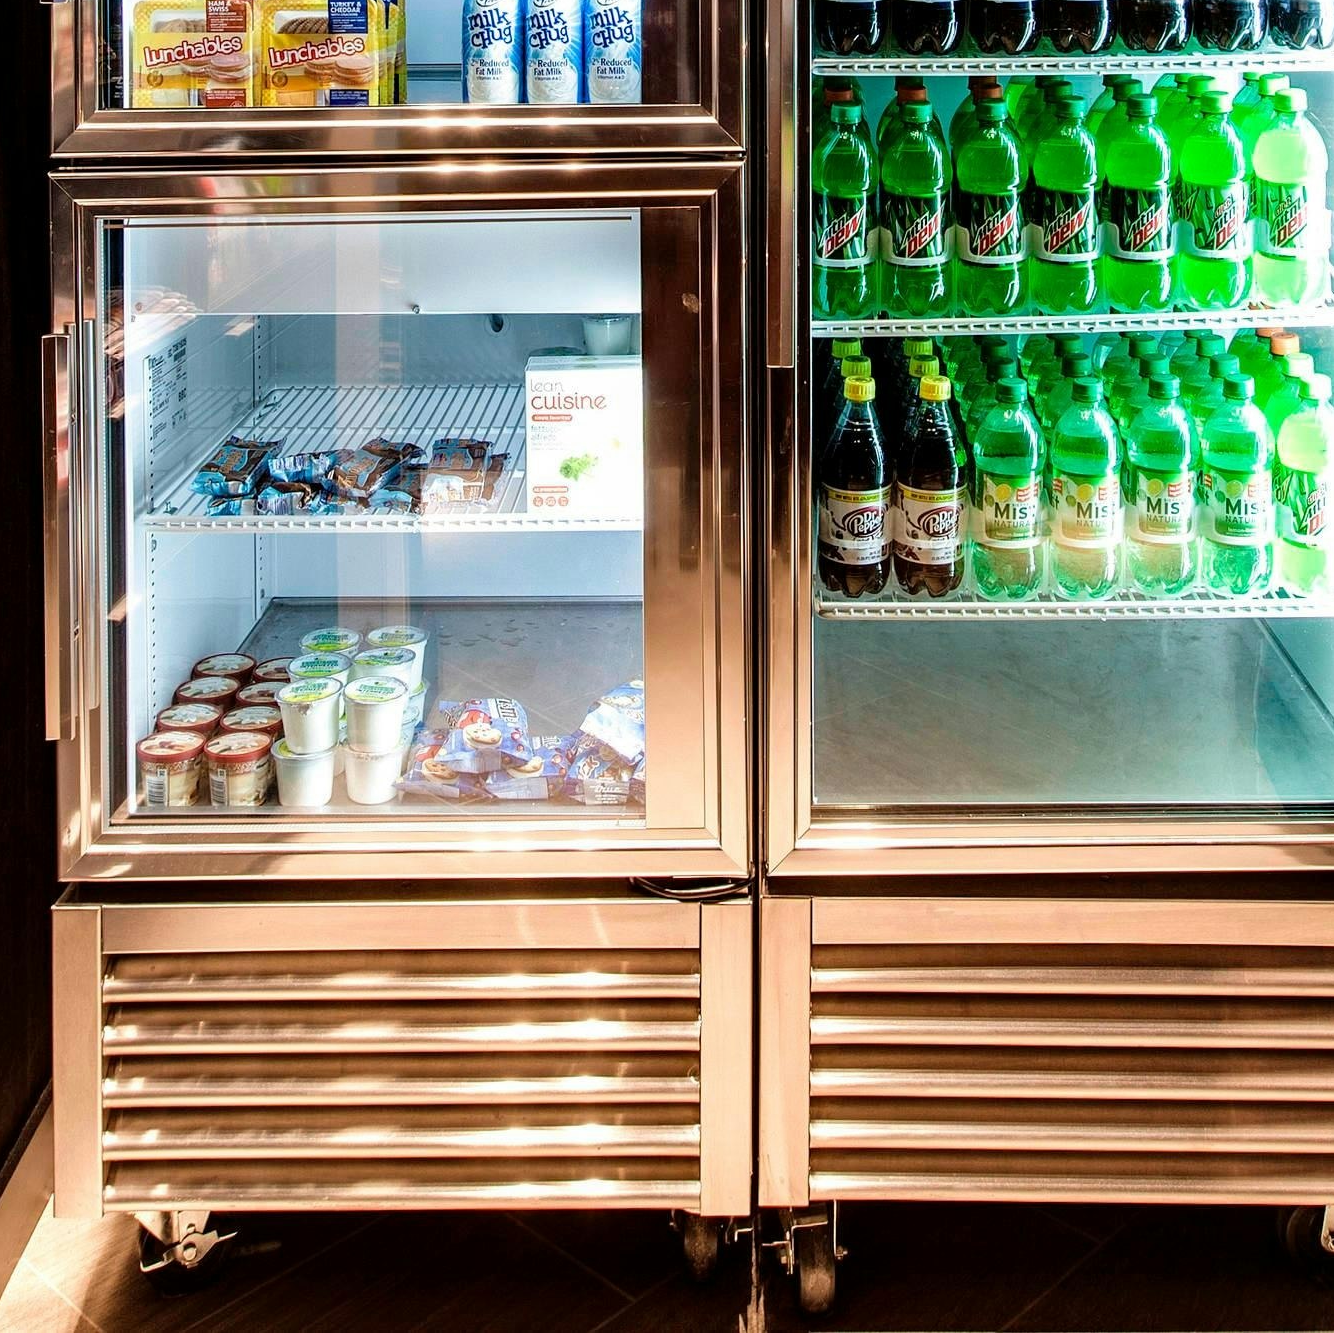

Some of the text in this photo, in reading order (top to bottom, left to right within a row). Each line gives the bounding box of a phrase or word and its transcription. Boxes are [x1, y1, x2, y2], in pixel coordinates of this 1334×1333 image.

[469, 8, 509, 31] milk
[528, 8, 567, 31] milk
[590, 6, 633, 31] milk
[144, 36, 243, 68] Lunchables
[268, 37, 365, 68] Lunchables
[480, 58, 510, 67] Reduced
[537, 59, 568, 68] Reduced
[600, 57, 632, 66] Reduced
[475, 67, 486, 76] Fat
[533, 67, 544, 76] Fat
[596, 66, 607, 75] Fat
[530, 378, 564, 393] lean
[531, 391, 607, 410] cuisine
[865, 510, 879, 524] Dr
[939, 510, 953, 524] Dr
